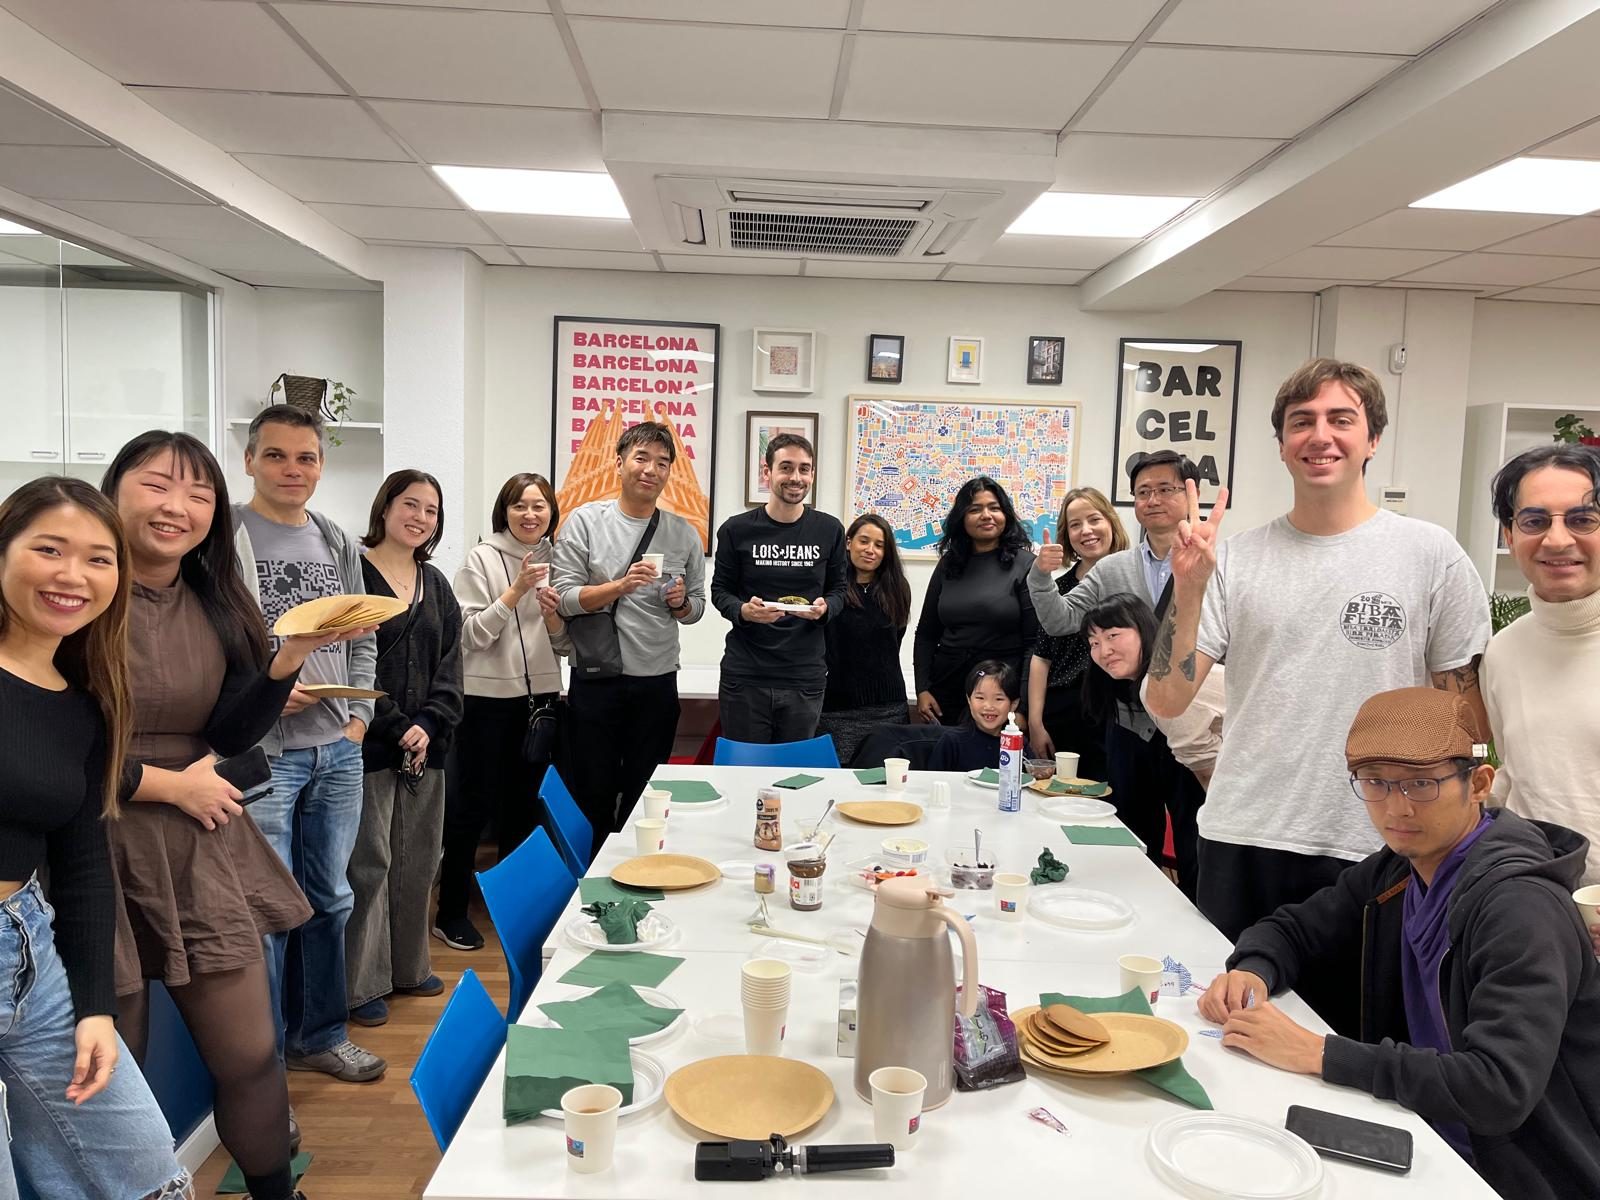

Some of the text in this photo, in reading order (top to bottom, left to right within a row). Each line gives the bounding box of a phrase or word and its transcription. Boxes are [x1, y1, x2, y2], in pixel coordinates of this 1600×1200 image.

[573, 332, 699, 351] BARCELONA
[573, 354, 698, 374] BARCELONA
[1135, 361, 1222, 397] BAR
[1136, 409, 1216, 442] CEL
[752, 544, 820, 560] LOIS JEANS
[1346, 602, 1401, 618] BIBA
[1343, 613, 1403, 629] FESTA
